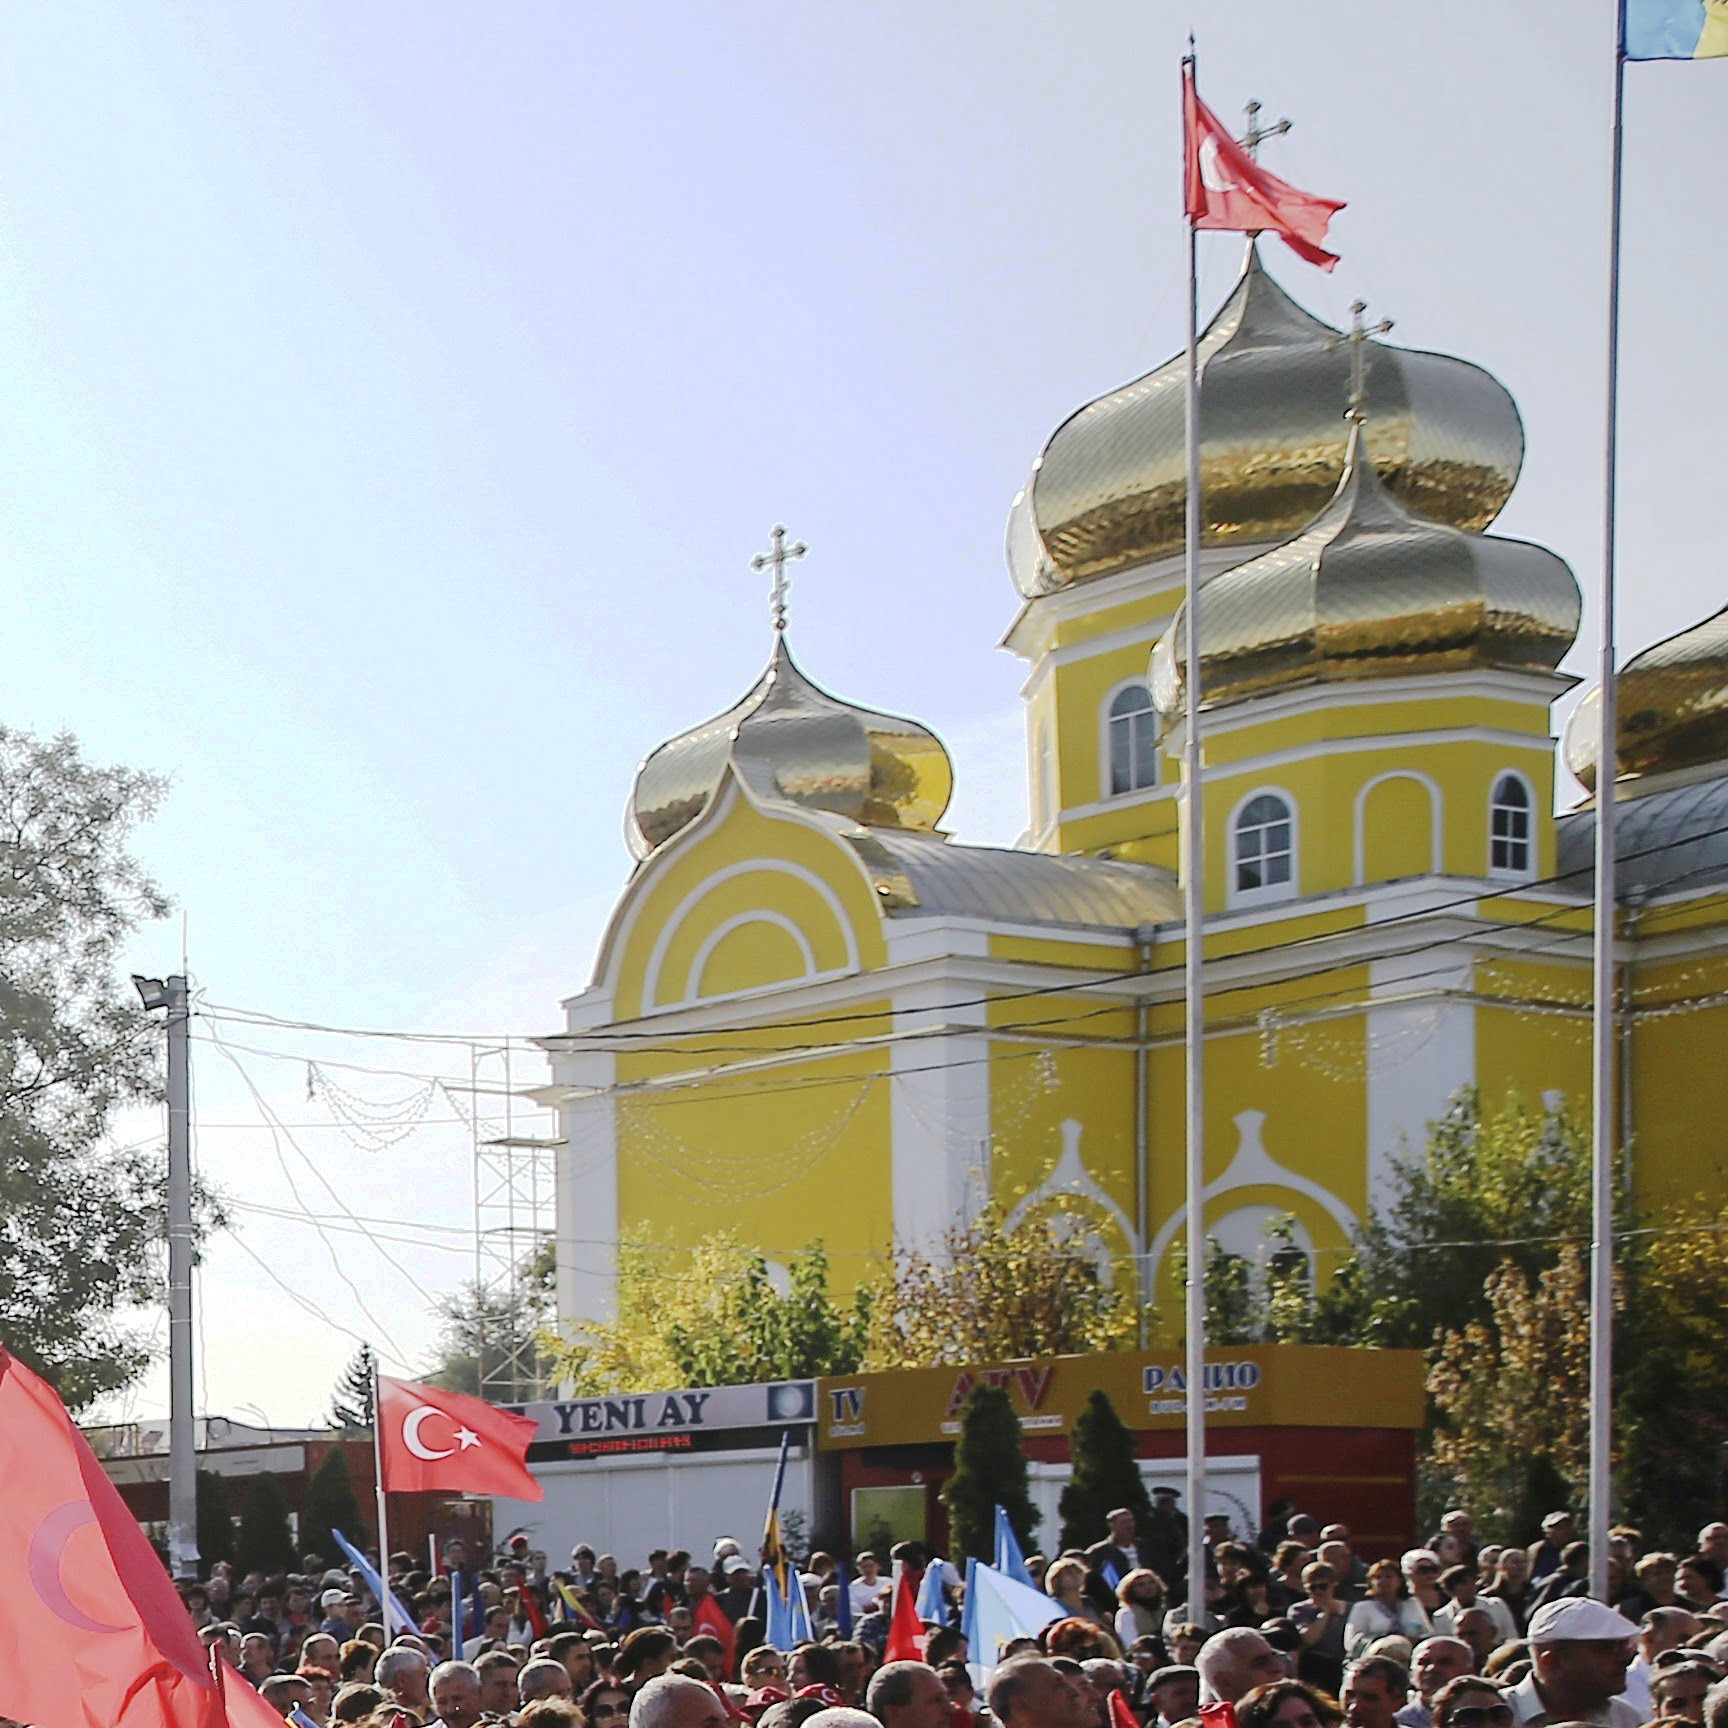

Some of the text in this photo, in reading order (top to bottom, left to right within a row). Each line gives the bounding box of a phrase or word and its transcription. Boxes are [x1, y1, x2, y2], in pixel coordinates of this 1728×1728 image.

[554, 1393, 710, 1434] YENI AY
[829, 1386, 867, 1422] TV
